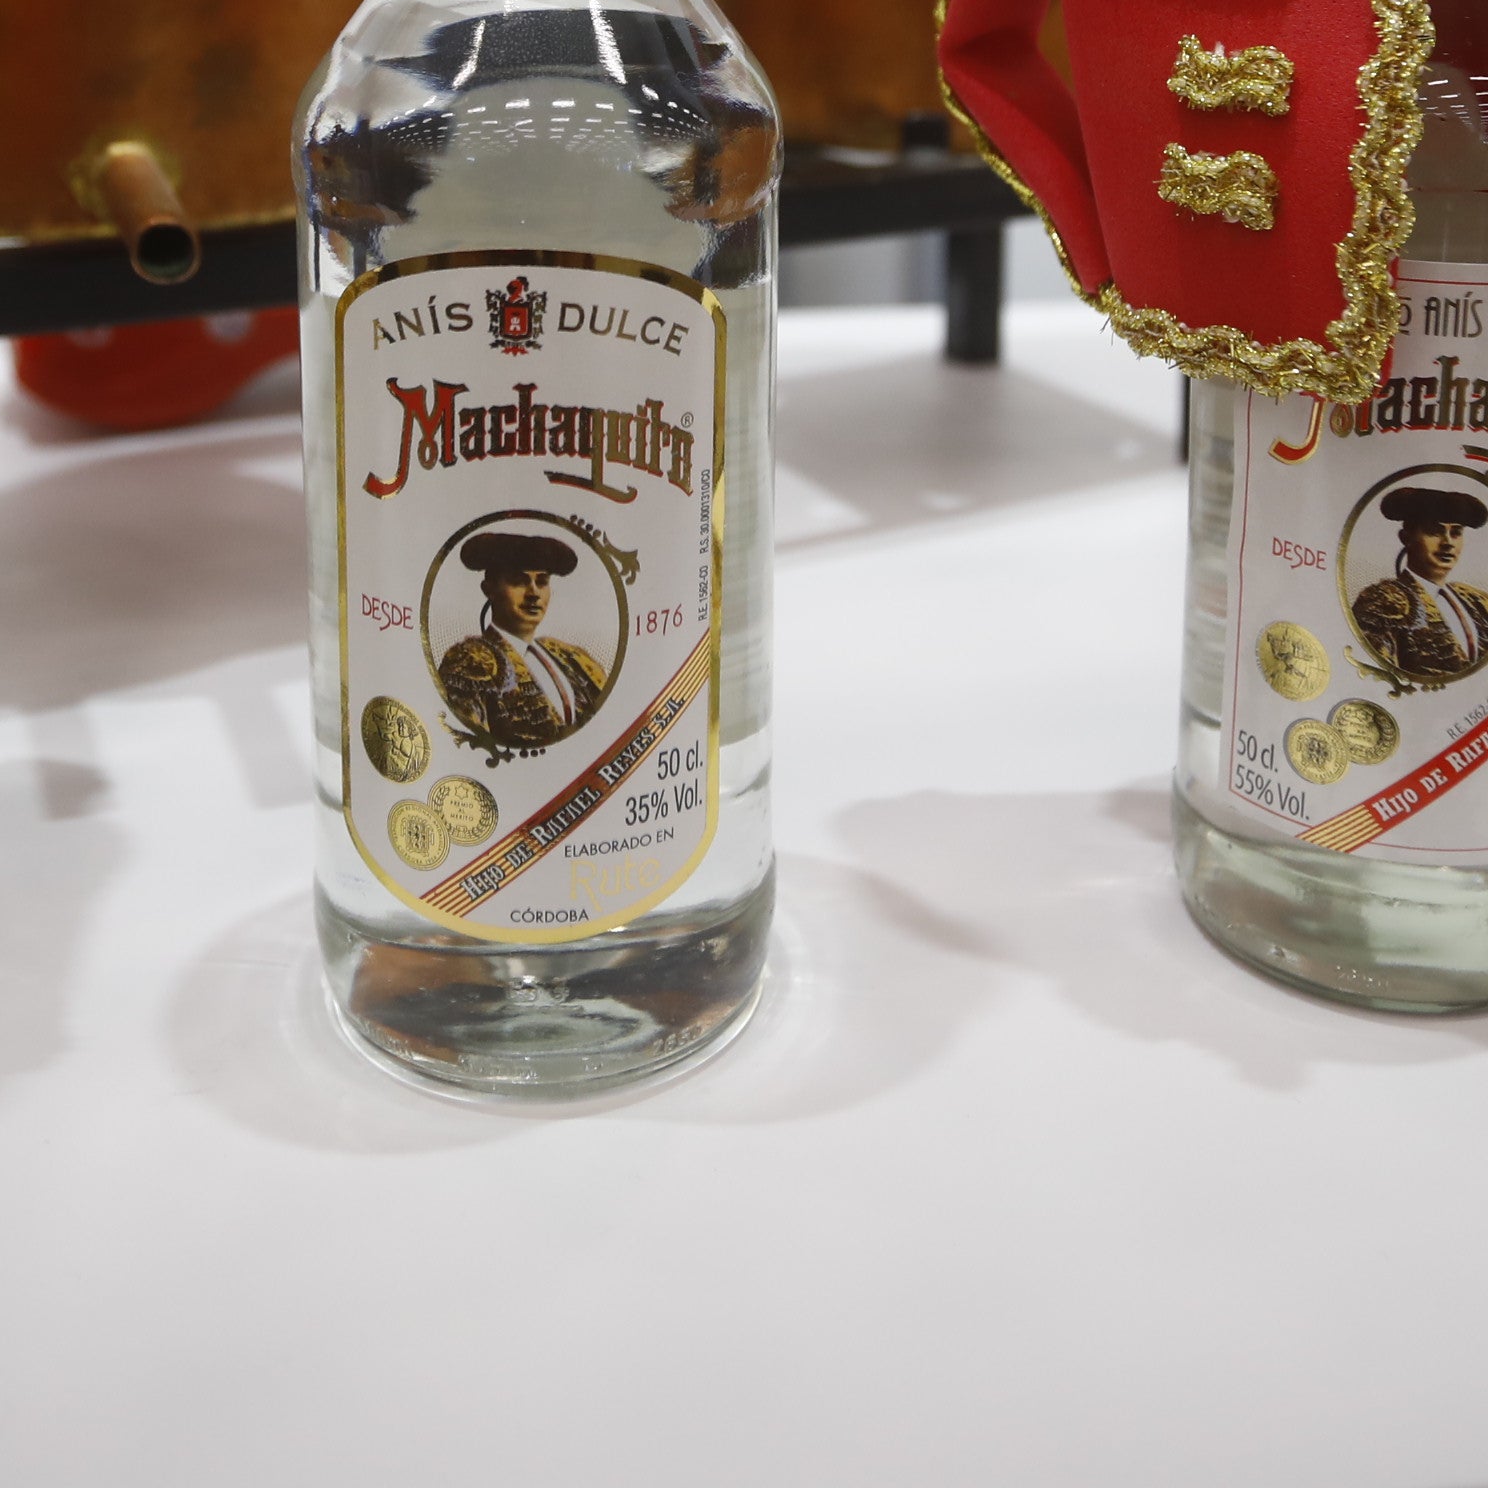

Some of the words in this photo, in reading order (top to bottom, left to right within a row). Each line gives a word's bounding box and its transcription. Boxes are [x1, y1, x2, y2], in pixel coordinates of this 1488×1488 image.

[372, 295, 474, 352] ANÍS
[558, 302, 690, 356] DULCE
[1424, 291, 1483, 338] ANÍS
[362, 377, 694, 504] Machaquito
[1272, 536, 1327, 571] DESDE
[362, 593, 414, 631] DESDE
[635, 604, 684, 637] 1876
[657, 747, 680, 781] 50
[686, 739, 704, 771] cl.
[1237, 729, 1257, 762] 50
[1261, 744, 1279, 773] cl.
[460, 865, 506, 902] HIJO
[506, 841, 534, 870] DE
[530, 785, 602, 848] RAFAEL
[597, 727, 657, 787] REYES
[625, 789, 669, 827] 35%
[674, 778, 703, 813] Vol.
[1234, 764, 1274, 808] 55%
[1277, 782, 1310, 821] Vol.
[1372, 785, 1419, 822] HIJO
[1420, 771, 1449, 794] DE
[564, 834, 652, 858] ELABORADO
[656, 827, 674, 843] EN
[570, 854, 661, 911] Rute
[510, 907, 589, 925] CÓRDOBA
